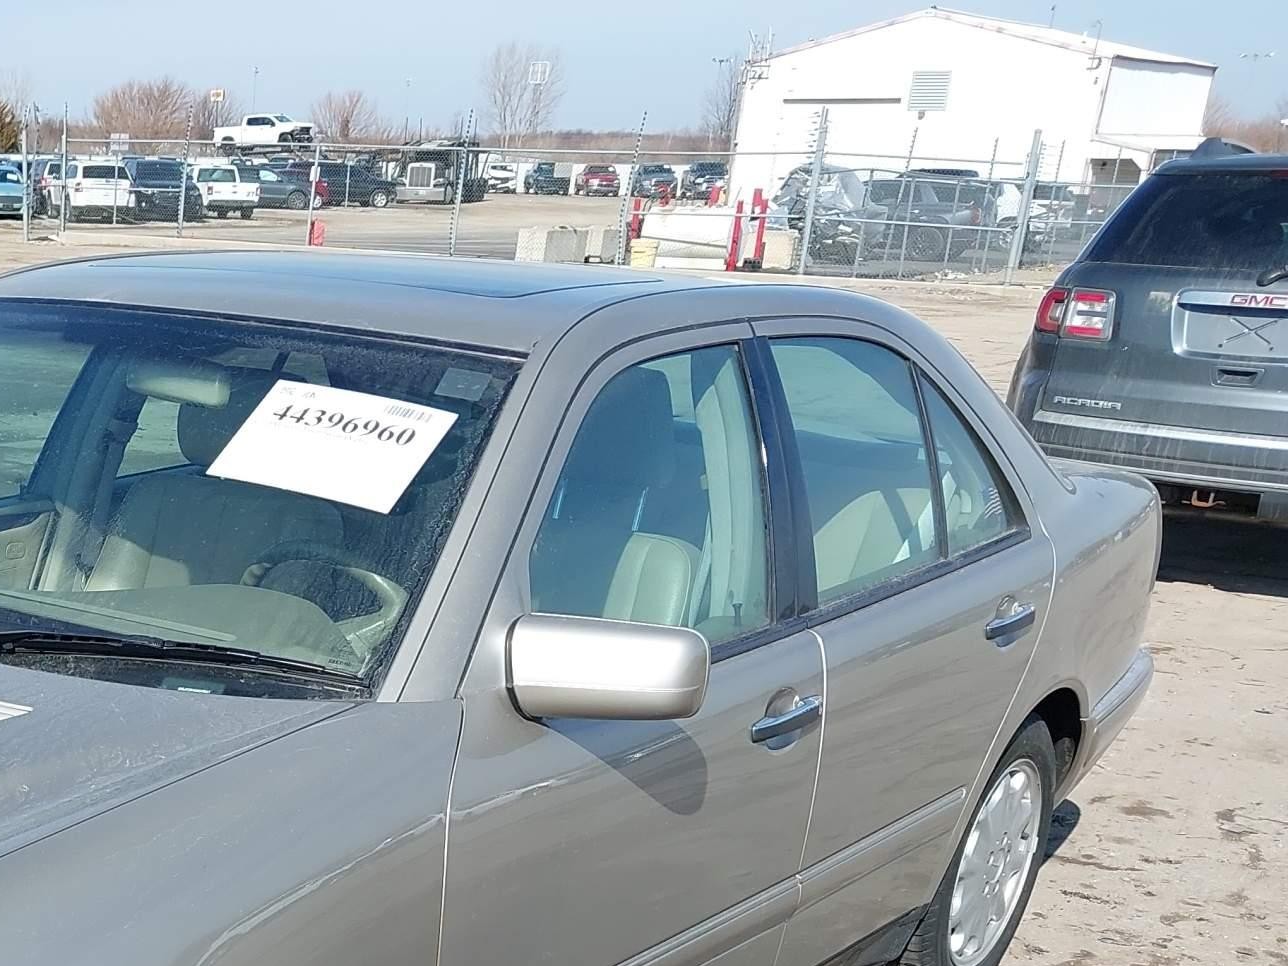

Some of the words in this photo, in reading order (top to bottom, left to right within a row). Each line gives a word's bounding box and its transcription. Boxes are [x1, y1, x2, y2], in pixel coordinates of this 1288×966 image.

[1230, 294, 1288, 307] GMC
[1053, 395, 1122, 411] ACADIA
[273, 404, 416, 446] 44396960
